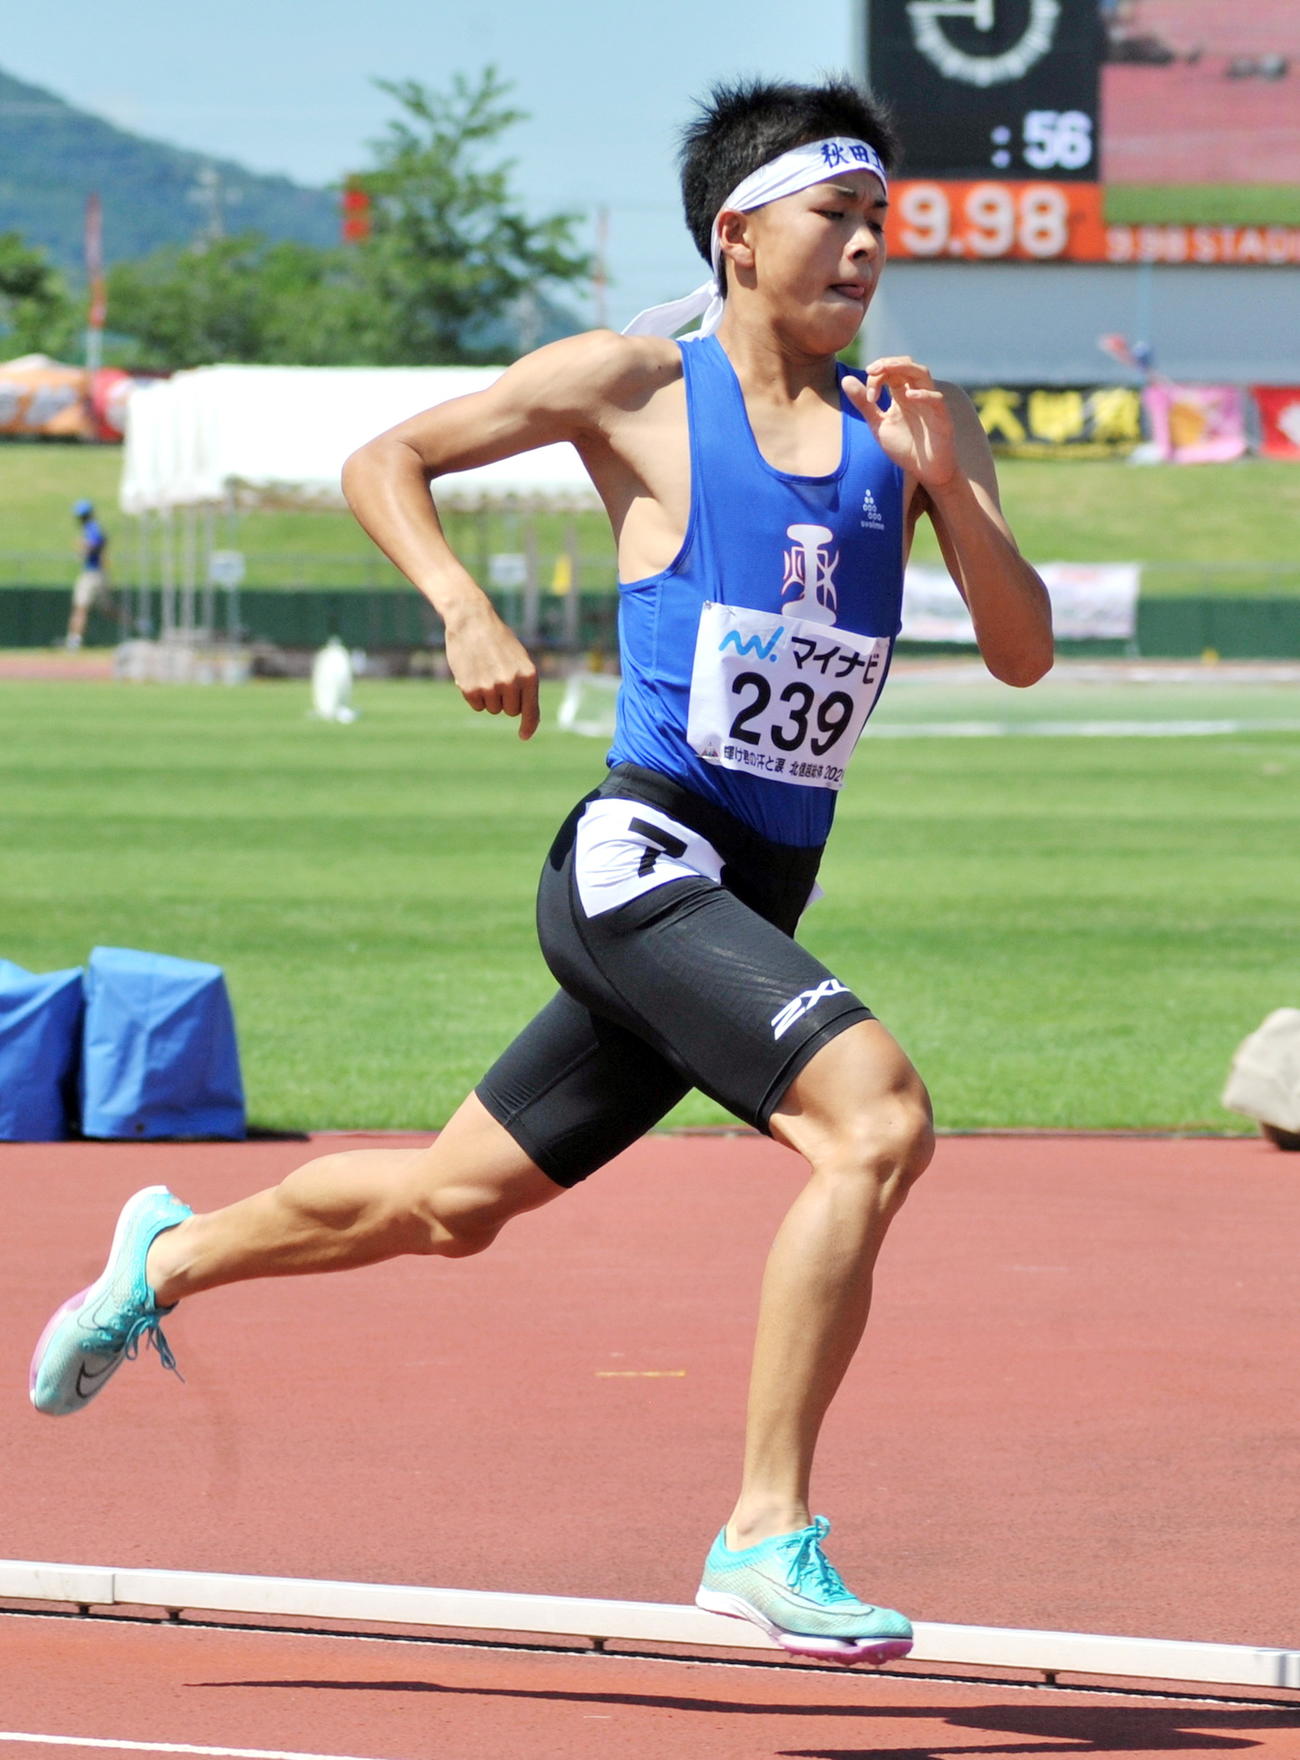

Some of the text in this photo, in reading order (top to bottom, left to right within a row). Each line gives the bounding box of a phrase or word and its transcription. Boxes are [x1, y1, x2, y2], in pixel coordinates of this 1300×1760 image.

[901, 185, 1068, 257] 9.98
[791, 635, 880, 685] マイナビ
[729, 671, 854, 757] 239
[627, 816, 688, 878] 7
